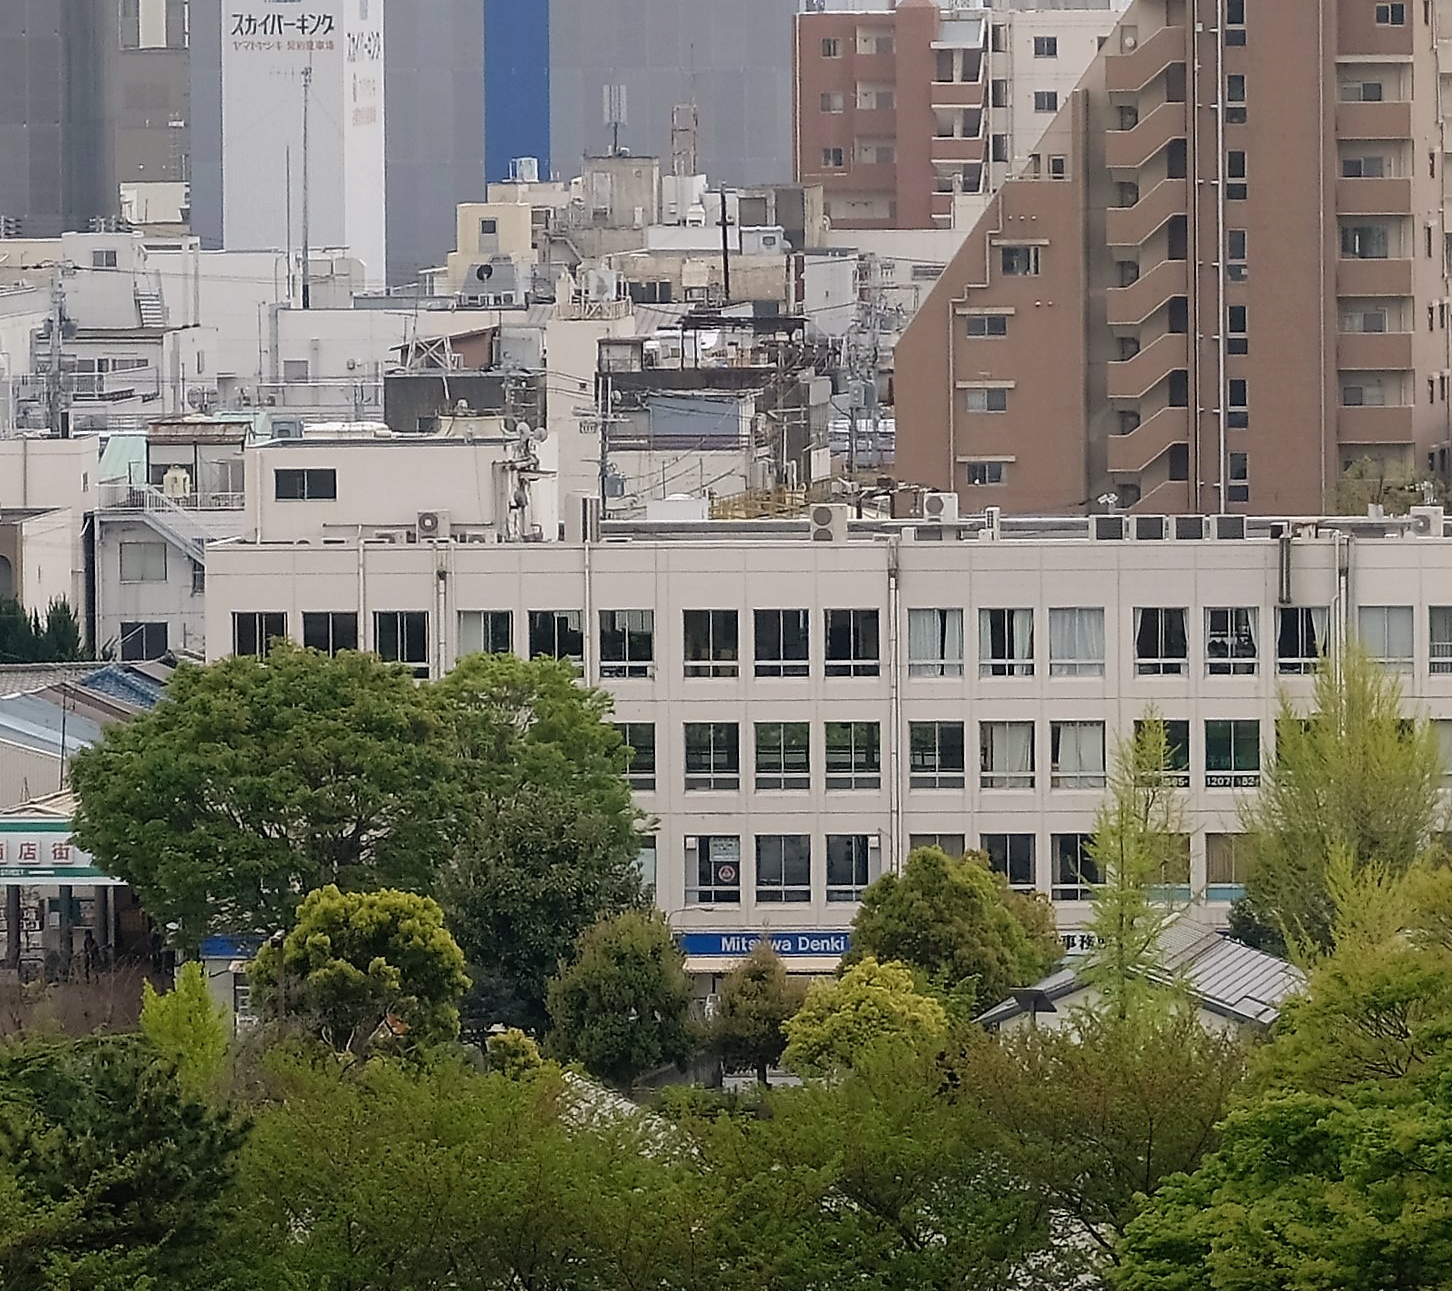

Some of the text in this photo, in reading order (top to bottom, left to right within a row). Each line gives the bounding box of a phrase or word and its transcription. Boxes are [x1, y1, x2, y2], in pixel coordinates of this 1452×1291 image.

[0, 841, 70, 861] 店街
[722, 935, 845, 952] Mitswa Denki
